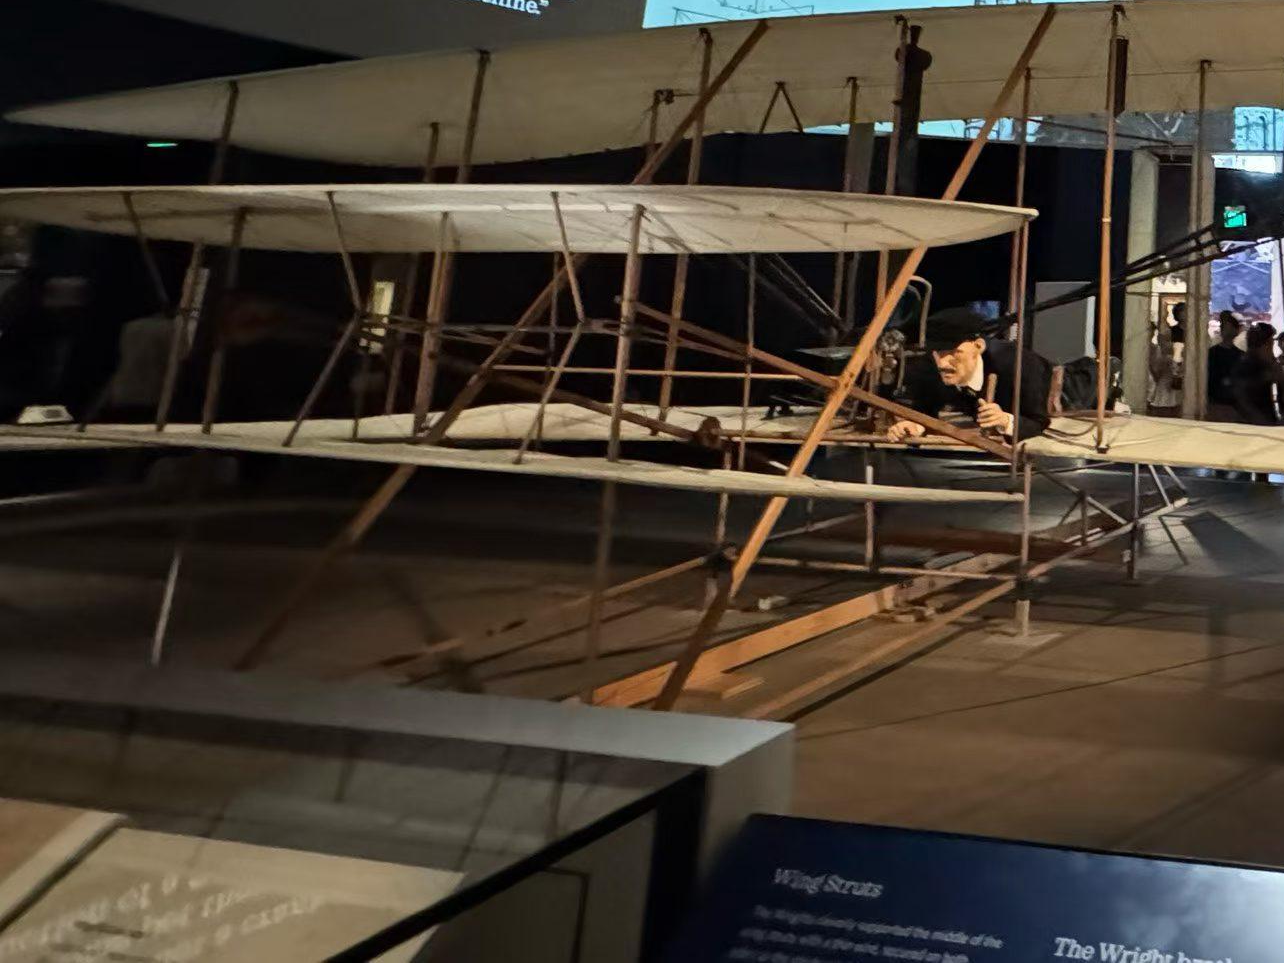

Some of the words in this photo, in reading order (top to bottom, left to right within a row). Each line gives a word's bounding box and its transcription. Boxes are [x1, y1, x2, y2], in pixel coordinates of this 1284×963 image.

[774, 868, 826, 895] Wing
[824, 874, 883, 898] Struts
[1053, 937, 1096, 961] The
